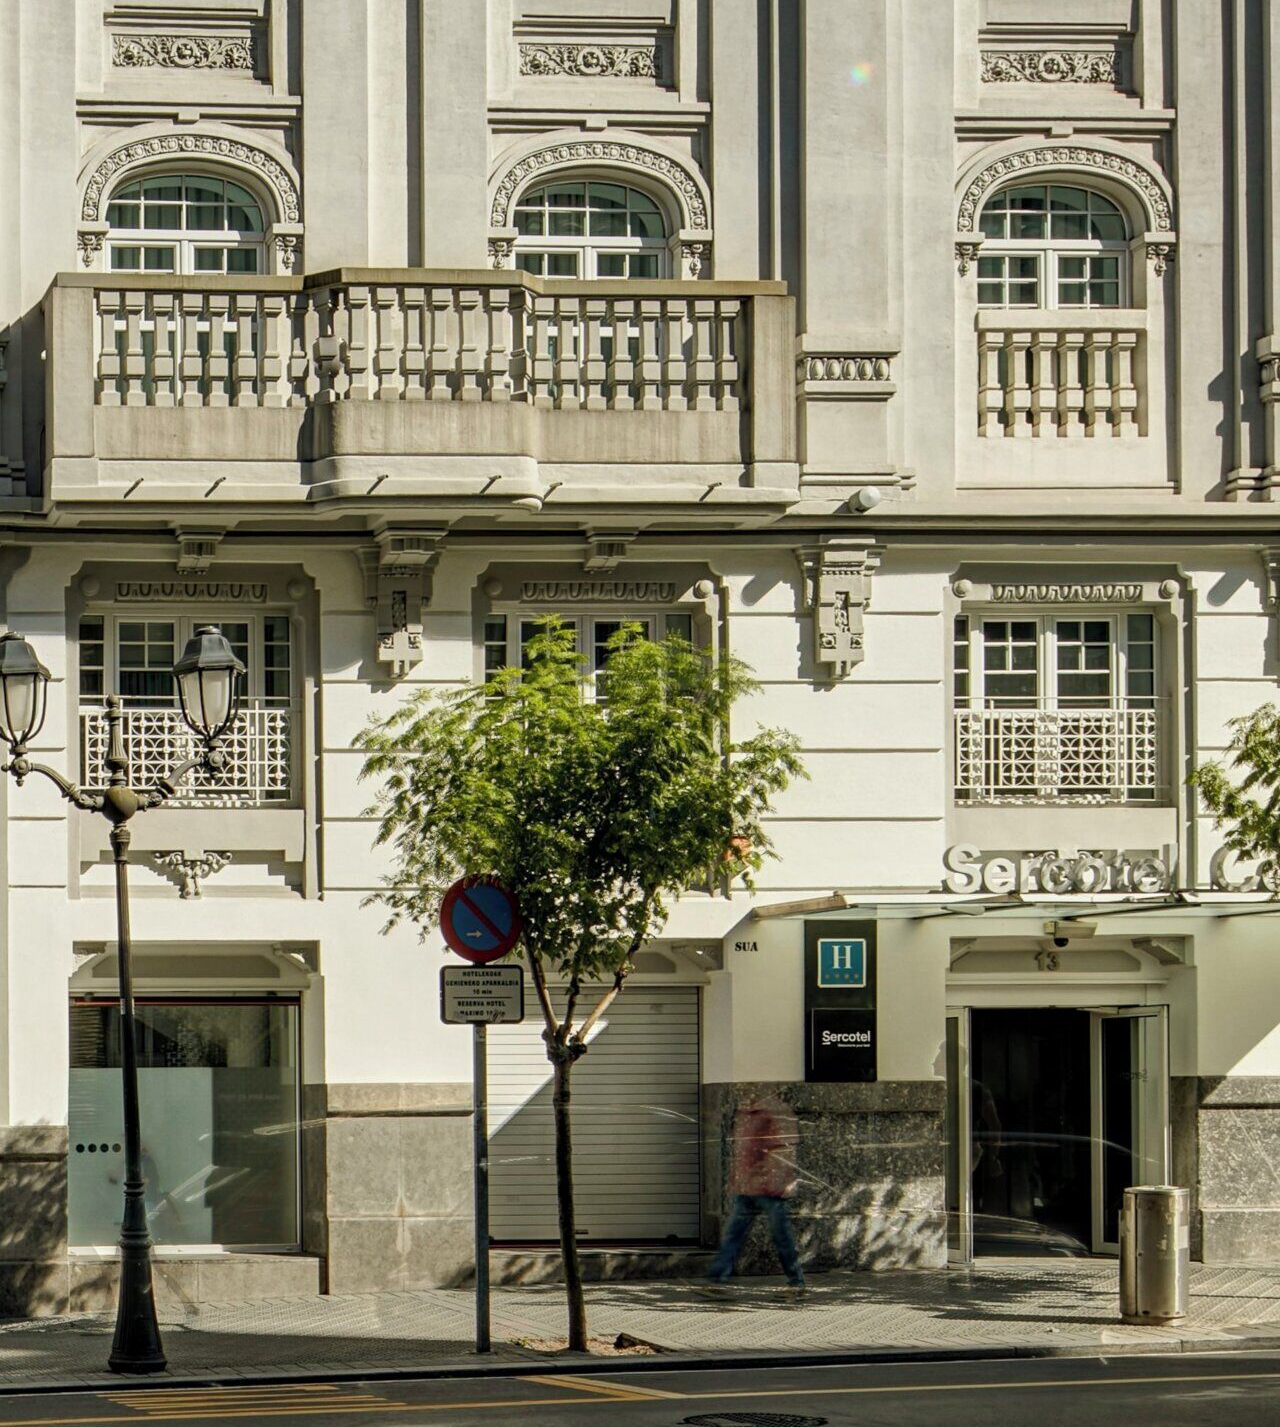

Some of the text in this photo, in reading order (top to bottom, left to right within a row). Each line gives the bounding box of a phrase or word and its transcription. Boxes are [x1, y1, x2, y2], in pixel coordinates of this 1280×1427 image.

[943, 843, 1178, 894] Sercotel
[735, 942, 758, 952] SUA
[832, 945, 853, 970] H
[1034, 952, 1057, 971] 13
[822, 1030, 871, 1042] Sercotel
